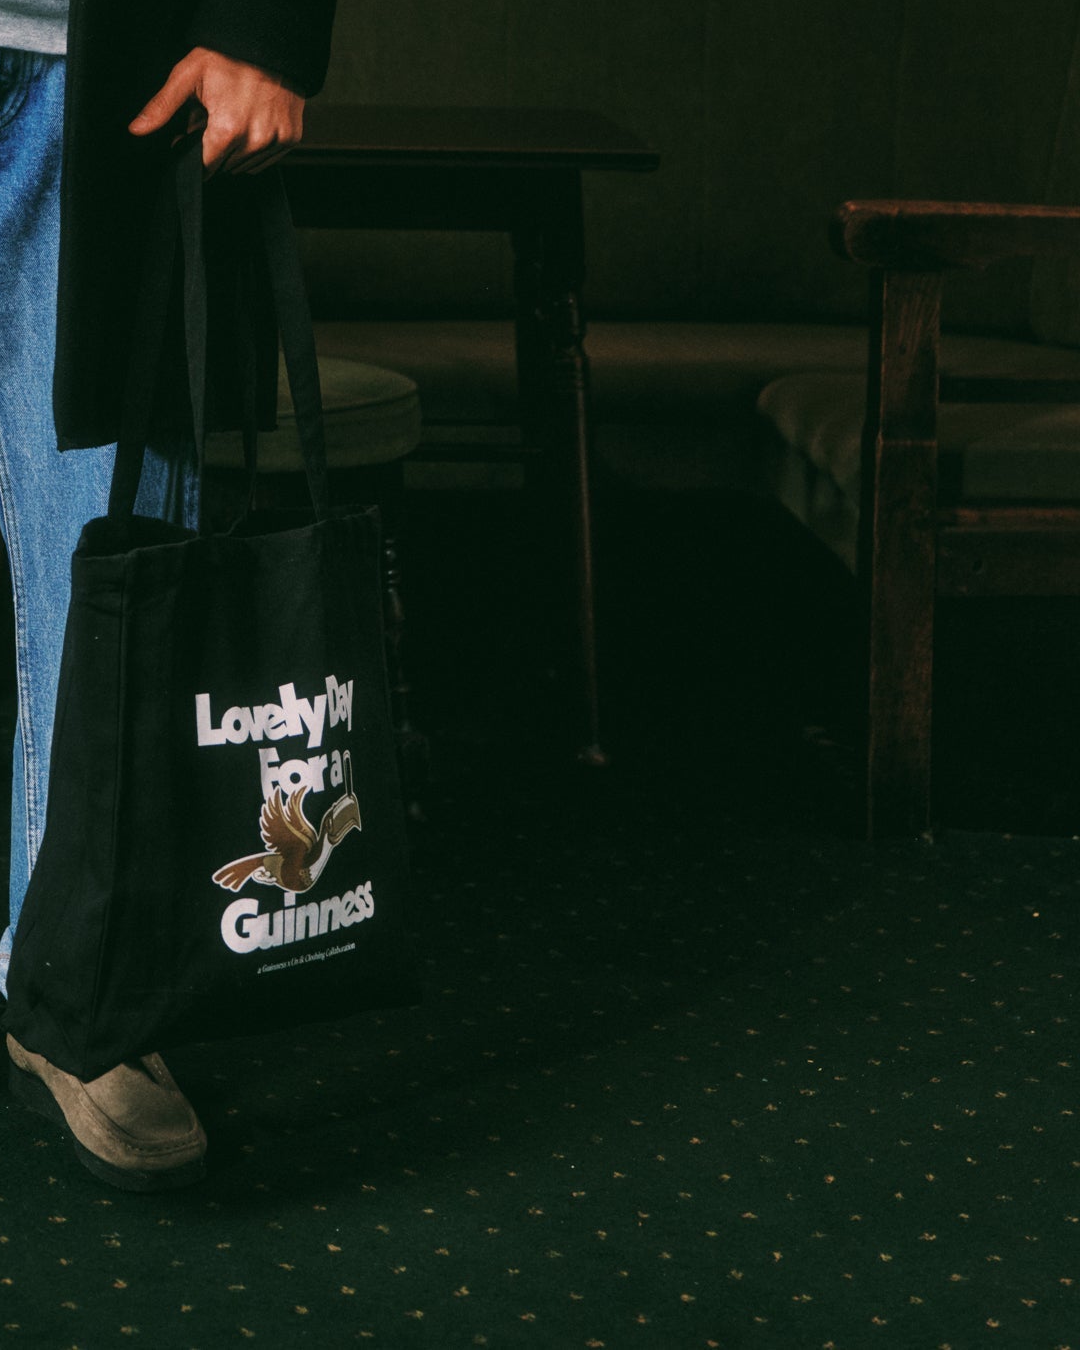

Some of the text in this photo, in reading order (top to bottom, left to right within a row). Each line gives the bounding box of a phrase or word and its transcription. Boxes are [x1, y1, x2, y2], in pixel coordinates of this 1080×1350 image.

[195, 675, 353, 748] Lovely Day
[258, 747, 343, 801] For a
[220, 881, 374, 954] Guinness
